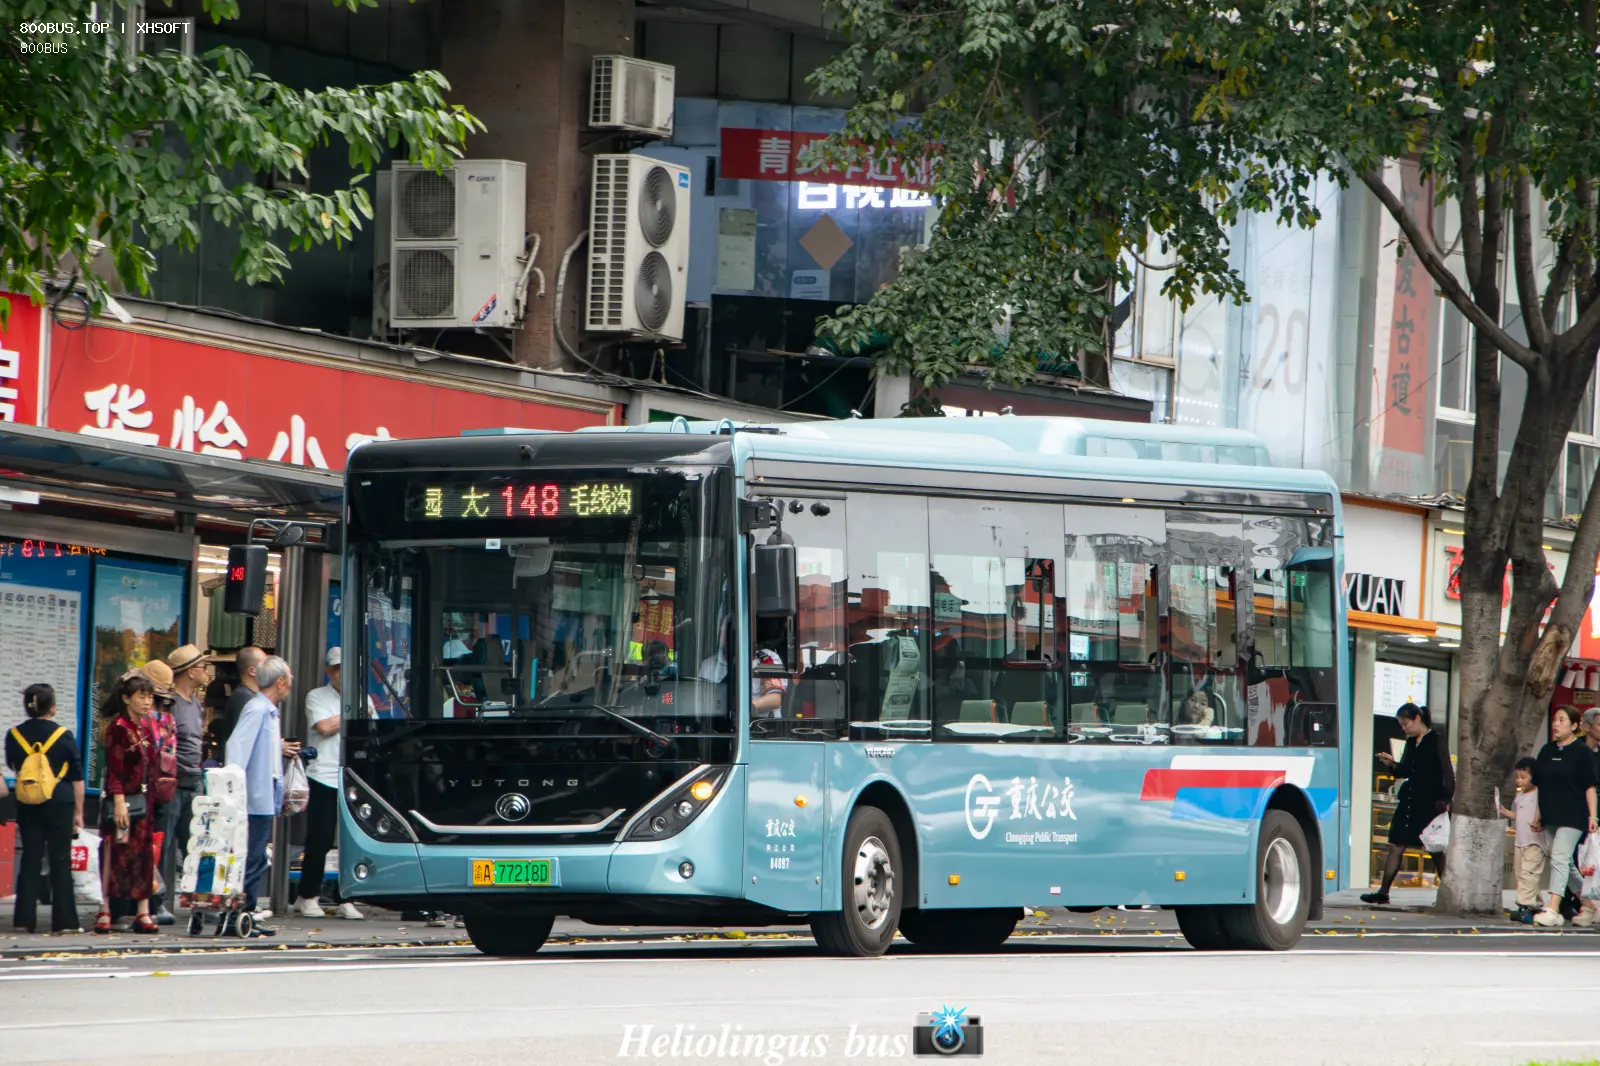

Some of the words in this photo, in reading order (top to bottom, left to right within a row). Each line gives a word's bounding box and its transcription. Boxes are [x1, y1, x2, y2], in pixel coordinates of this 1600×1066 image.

[79, 384, 398, 470] 华怡小
[502, 485, 560, 517] 148
[231, 566, 245, 582] 148
[448, 779, 579, 788] YUTONG
[1005, 776, 1078, 821] 重庆公交
[765, 817, 797, 838] 重庆公交
[1005, 832, 1034, 846] Chongqing
[1034, 832, 1052, 843] Public
[1052, 832, 1078, 845] Transport
